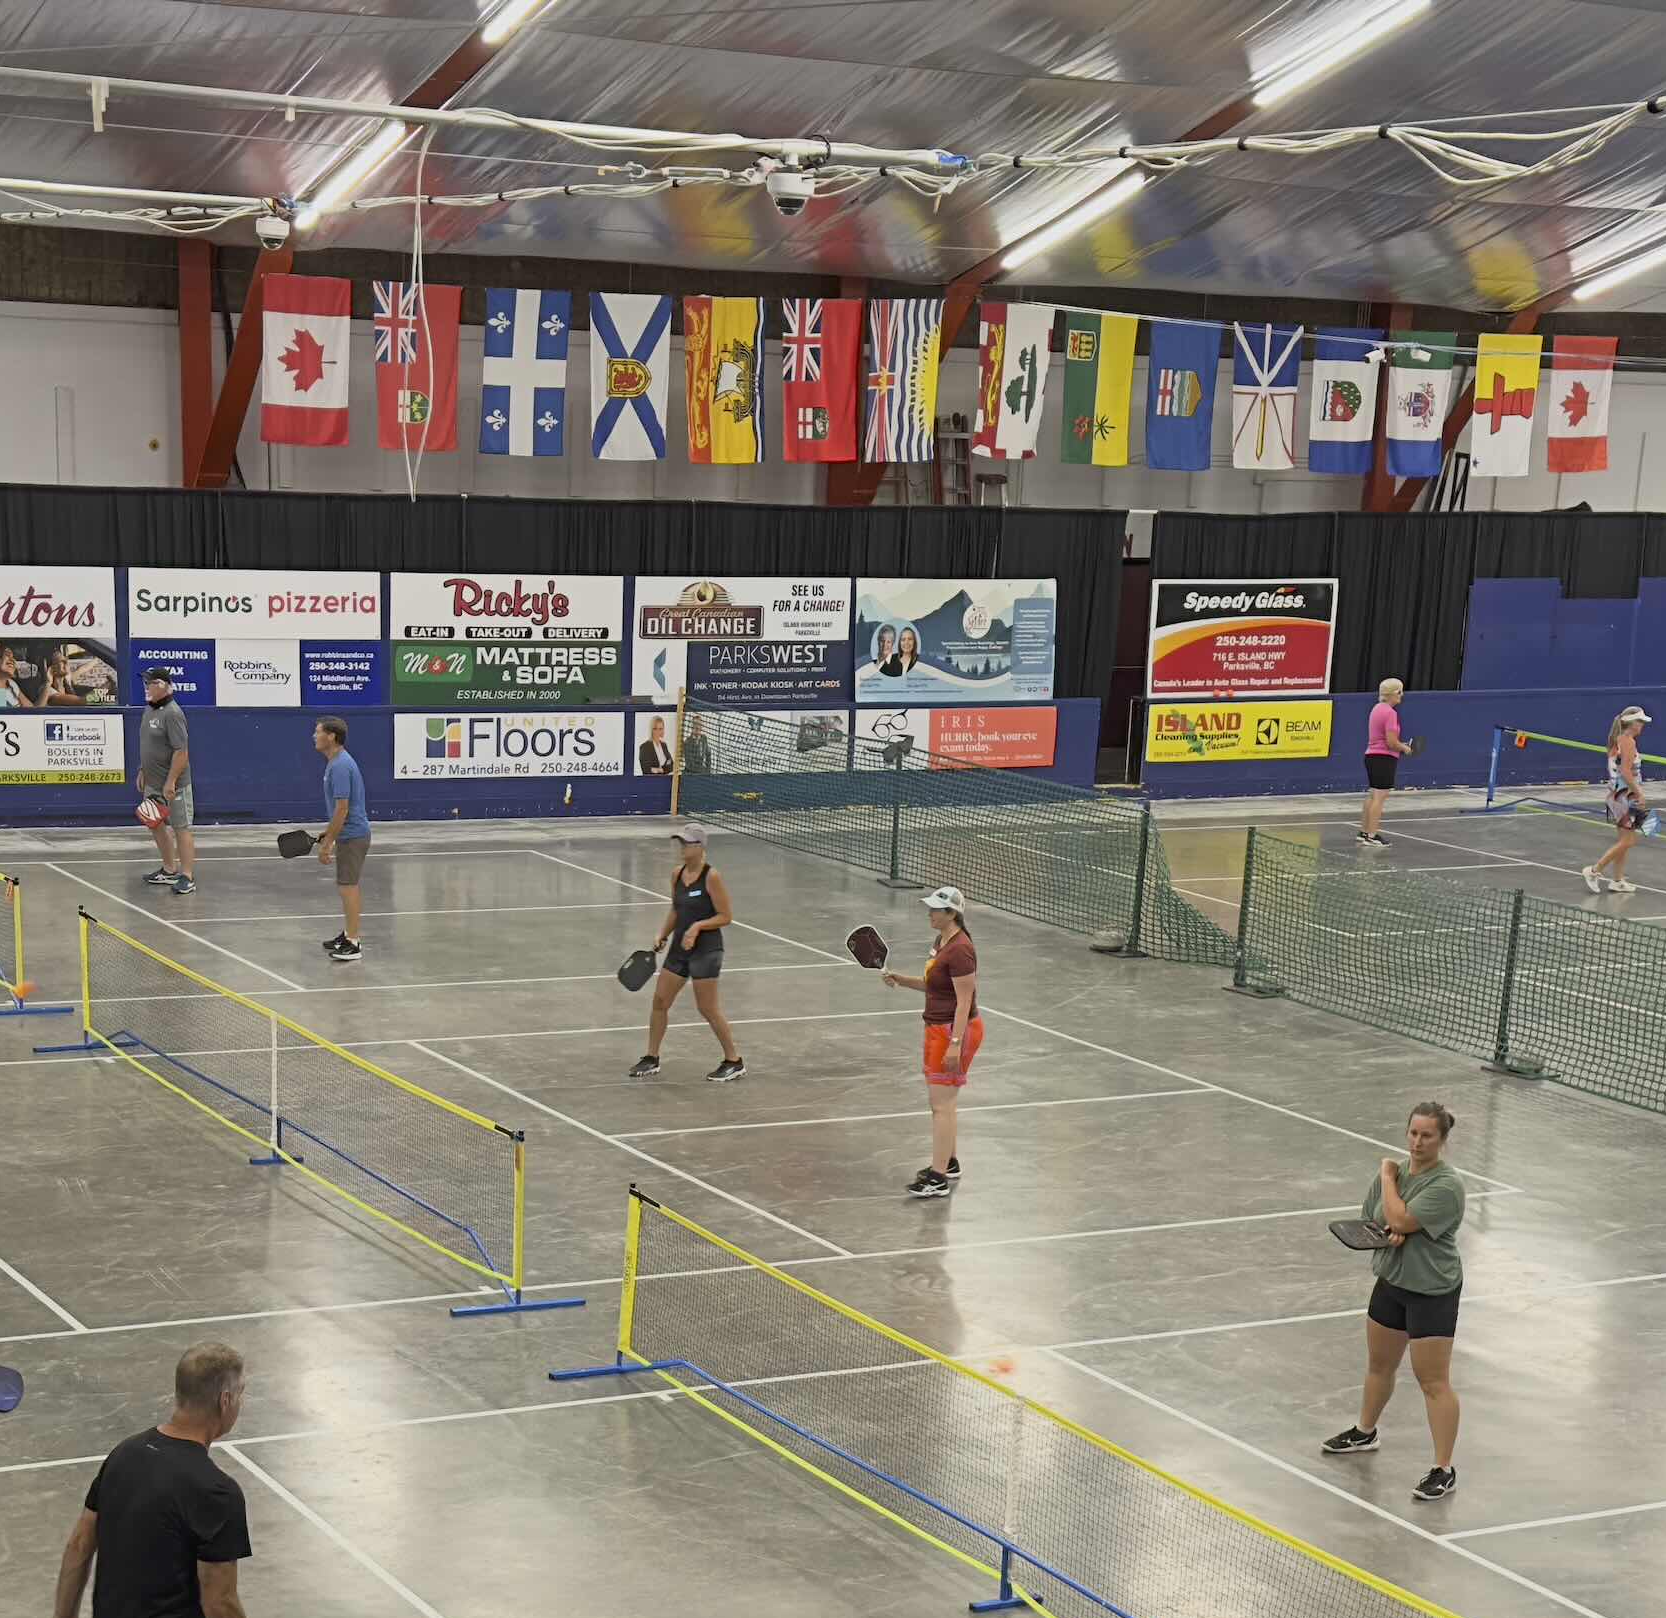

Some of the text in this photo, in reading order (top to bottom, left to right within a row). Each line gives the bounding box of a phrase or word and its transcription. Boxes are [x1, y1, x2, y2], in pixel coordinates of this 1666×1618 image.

[791, 585, 824, 596] SEE US
[136, 588, 376, 618] Sarpinos pizzeria
[444, 578, 569, 626] Ricky's
[773, 600, 845, 612] FOR A CHANGE!
[1183, 591, 1303, 613] Speedy Glass
[660, 608, 743, 618] Great Canadian
[647, 617, 756, 634] OIL CHANGE
[411, 628, 449, 638] EAT-IN
[470, 628, 528, 638] TAKE-OUT
[547, 628, 603, 638] DELIVERY
[1216, 635, 1286, 647] 250-248-2220
[138, 650, 208, 660] ACCOUNTING
[476, 648, 617, 665] MATTRESS
[709, 644, 828, 665] PARKSWEST
[1213, 653, 1227, 661] 716
[1238, 652, 1267, 661] ISLAND
[1268, 651, 1286, 661] HWY
[224, 660, 272, 670] Robbins
[309, 662, 370, 671] 250-248-3142
[1223, 661, 1275, 671] Parksville, BC
[234, 671, 291, 685] Company
[502, 666, 585, 685] & SOFA
[317, 684, 352, 692] Parksville,
[712, 682, 738, 690] TONER
[741, 681, 768, 689] KODAK
[770, 681, 794, 689] KIOSK
[815, 680, 841, 688] CARDS
[1183, 679, 1205, 687] Leader
[1214, 678, 1229, 686] Auto
[457, 690, 560, 700] ESTABLISHED IN 2000
[504, 716, 596, 727] UNITED
[941, 715, 985, 728] IRIS
[1156, 712, 1242, 732] ISLAND
[1286, 720, 1321, 732] BEAM
[66, 732, 101, 742] facebook
[469, 718, 596, 758] Floors
[940, 732, 1037, 744] HURRY, book your eye
[1155, 732, 1239, 741] Cleaning Supplies
[47, 748, 90, 756] BOSLEYS
[940, 743, 993, 754] exam today.
[47, 758, 104, 766] PARKSVILLE
[540, 761, 620, 774] 250-248-4664
[400, 763, 530, 776] 4 287 Martindale Rd
[58, 773, 122, 782] 250-248-2673
